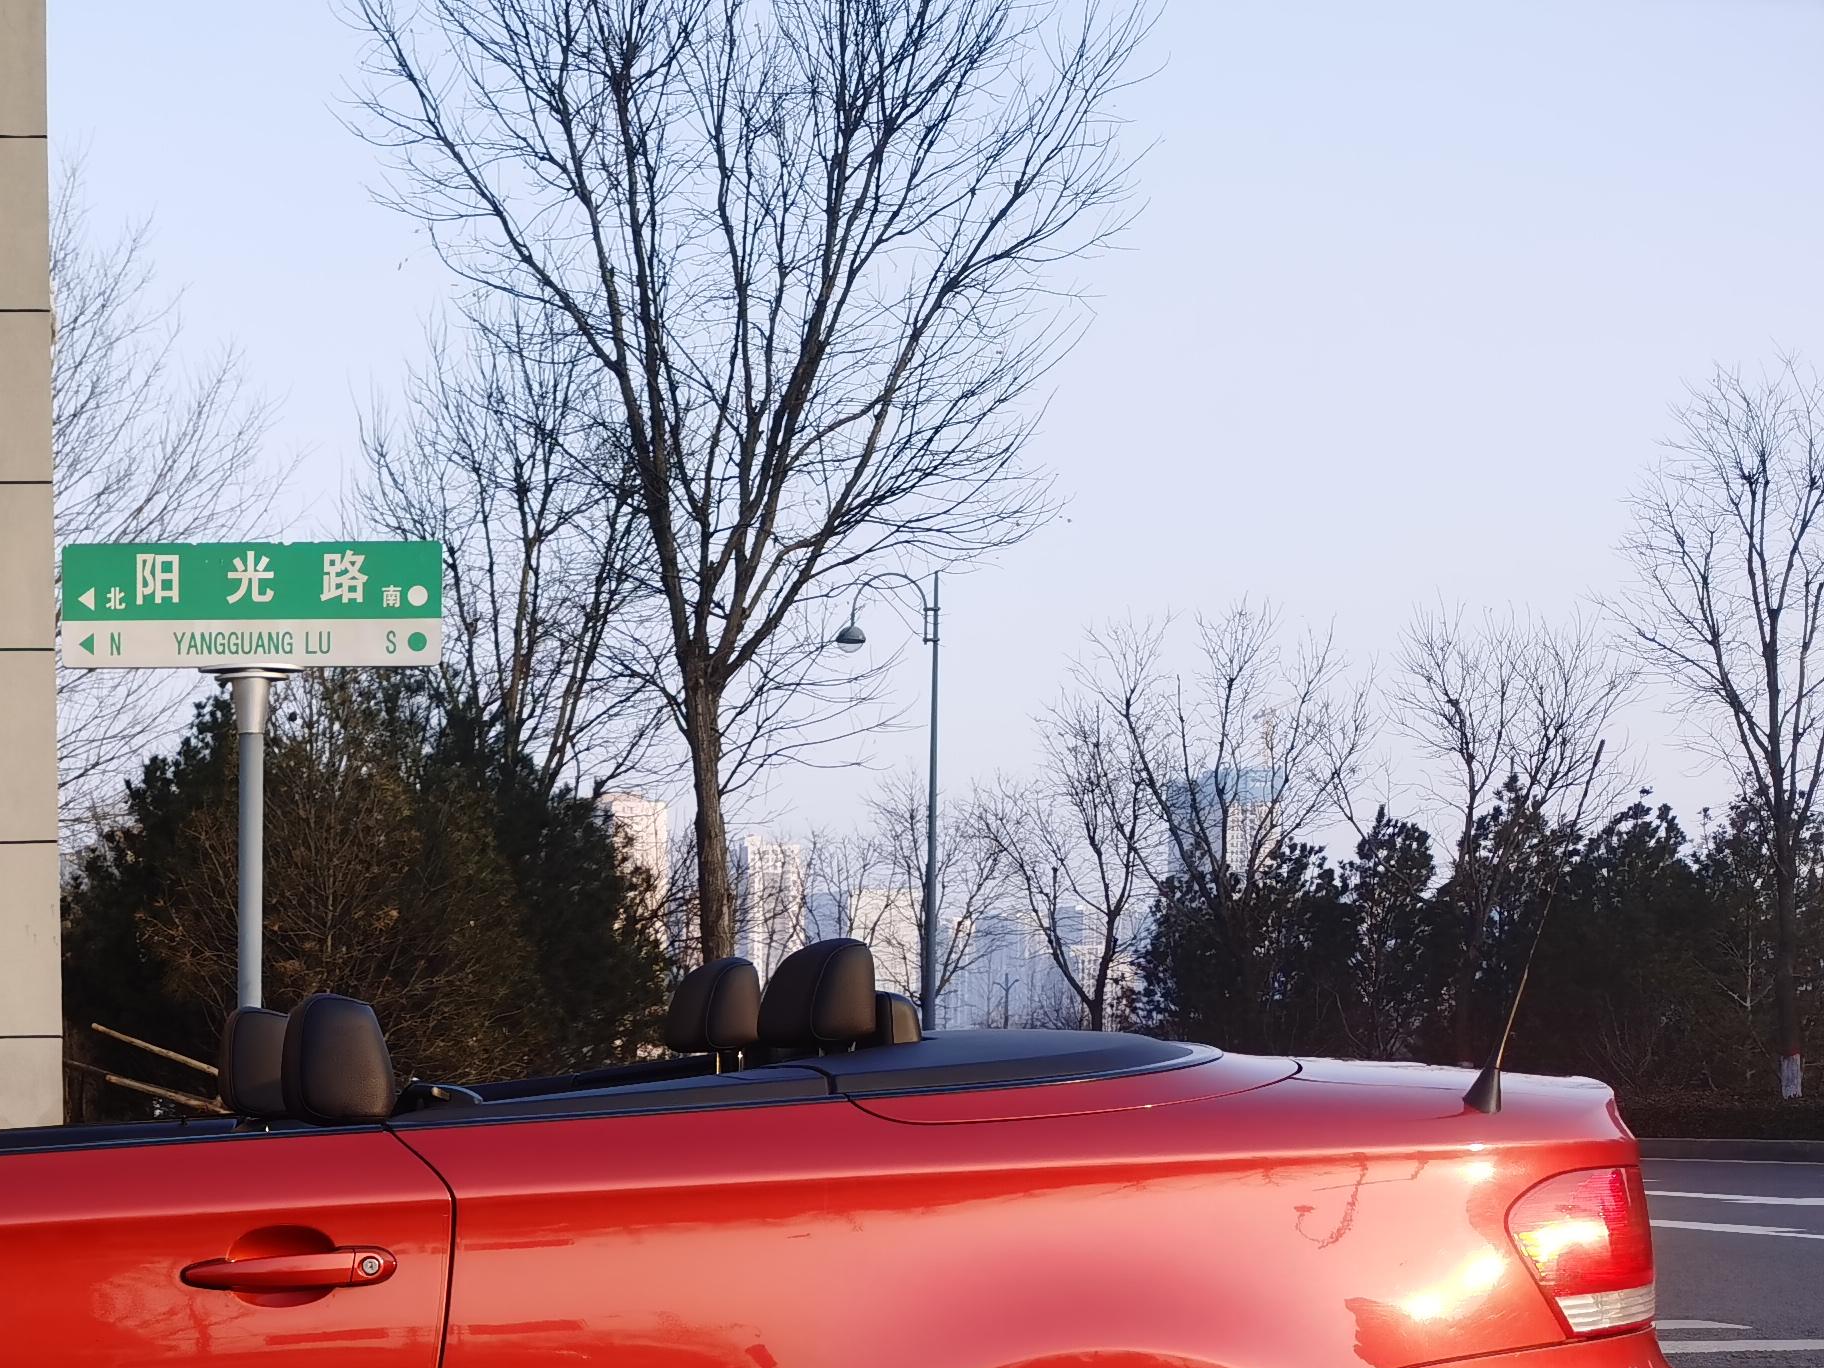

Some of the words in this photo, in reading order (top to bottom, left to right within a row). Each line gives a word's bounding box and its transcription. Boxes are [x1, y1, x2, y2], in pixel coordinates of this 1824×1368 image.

[136, 550, 369, 605] 阳光路
[105, 586, 126, 610] 北
[381, 584, 402, 608] 南
[110, 631, 121, 656] N
[173, 631, 294, 656] YANGGUANG
[305, 631, 331, 654] LU
[385, 630, 397, 655] S
